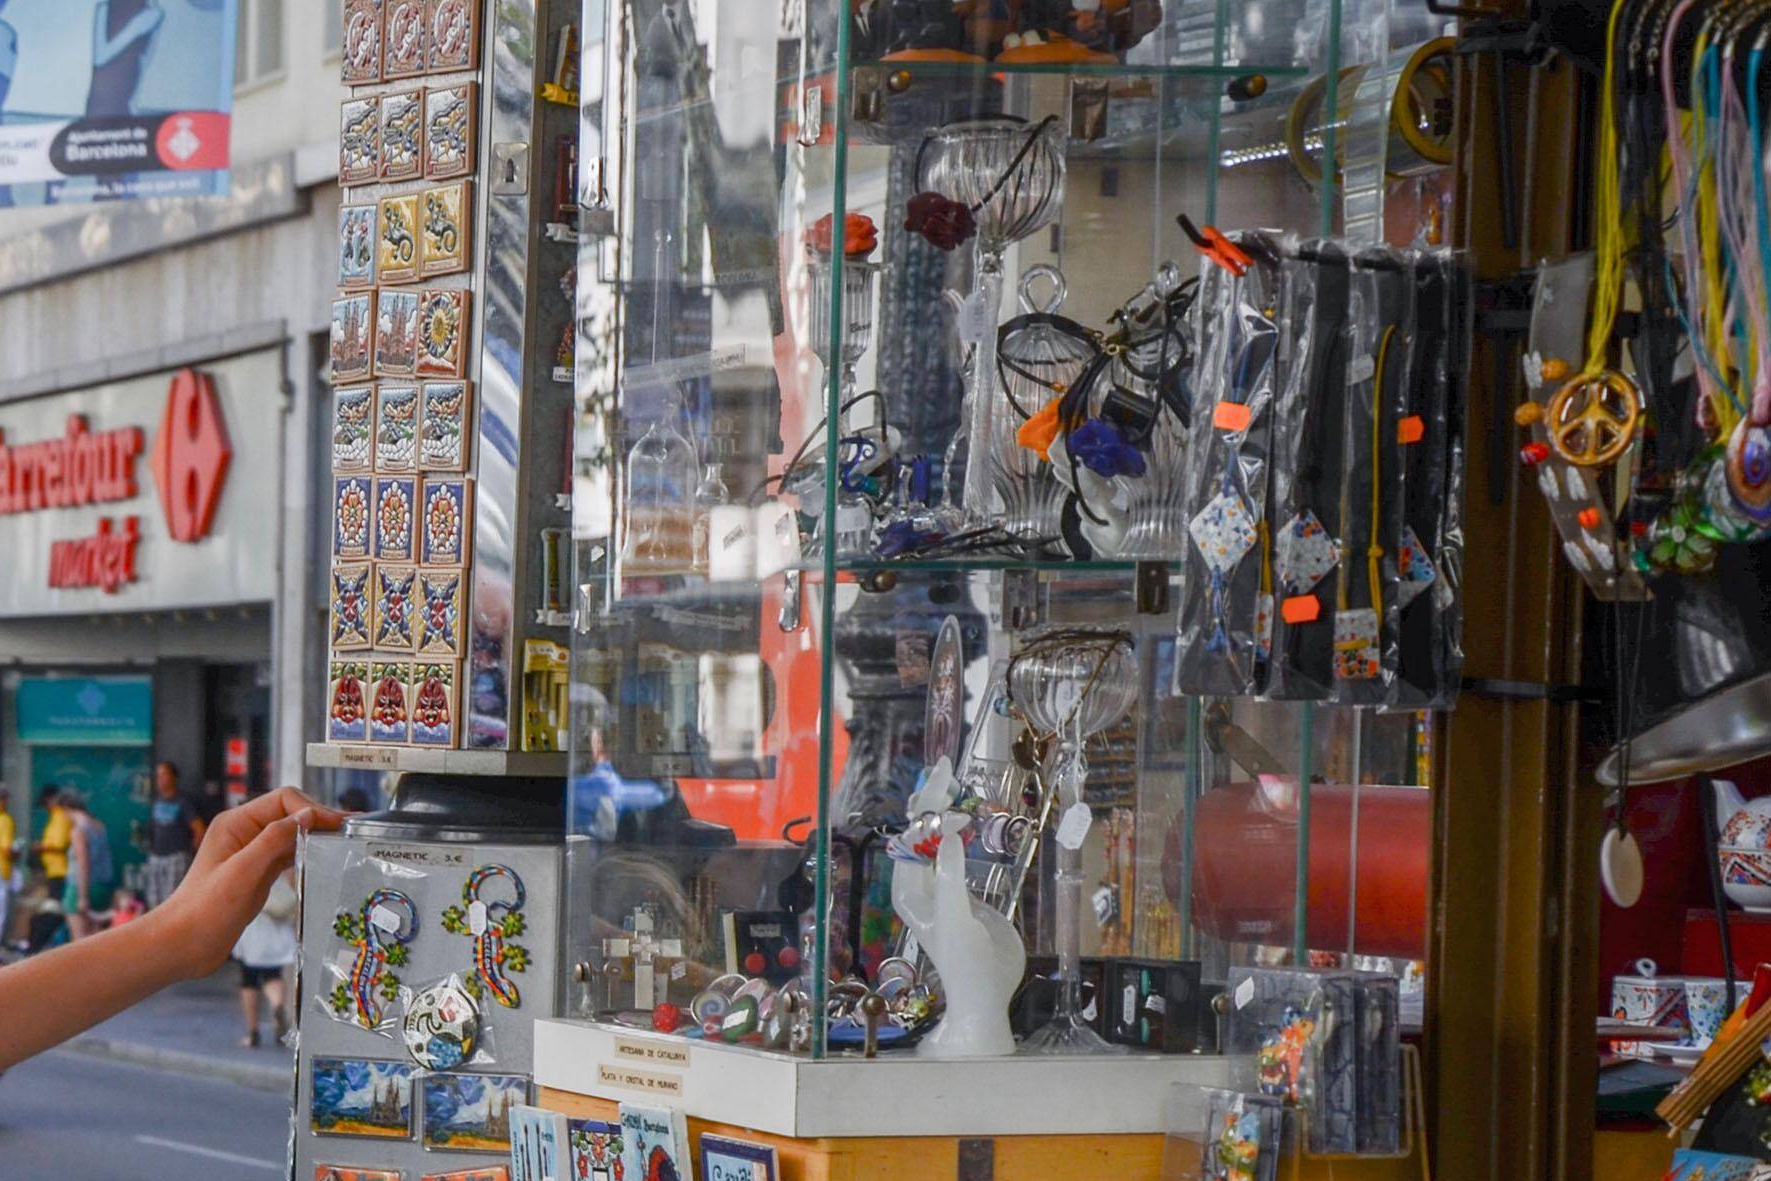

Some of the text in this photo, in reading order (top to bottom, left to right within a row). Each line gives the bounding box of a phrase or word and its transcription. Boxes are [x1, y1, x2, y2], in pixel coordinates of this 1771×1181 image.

[66, 143, 148, 161] Barcelona
[48, 515, 142, 594] market
[376, 850, 428, 861] MAGNETIC
